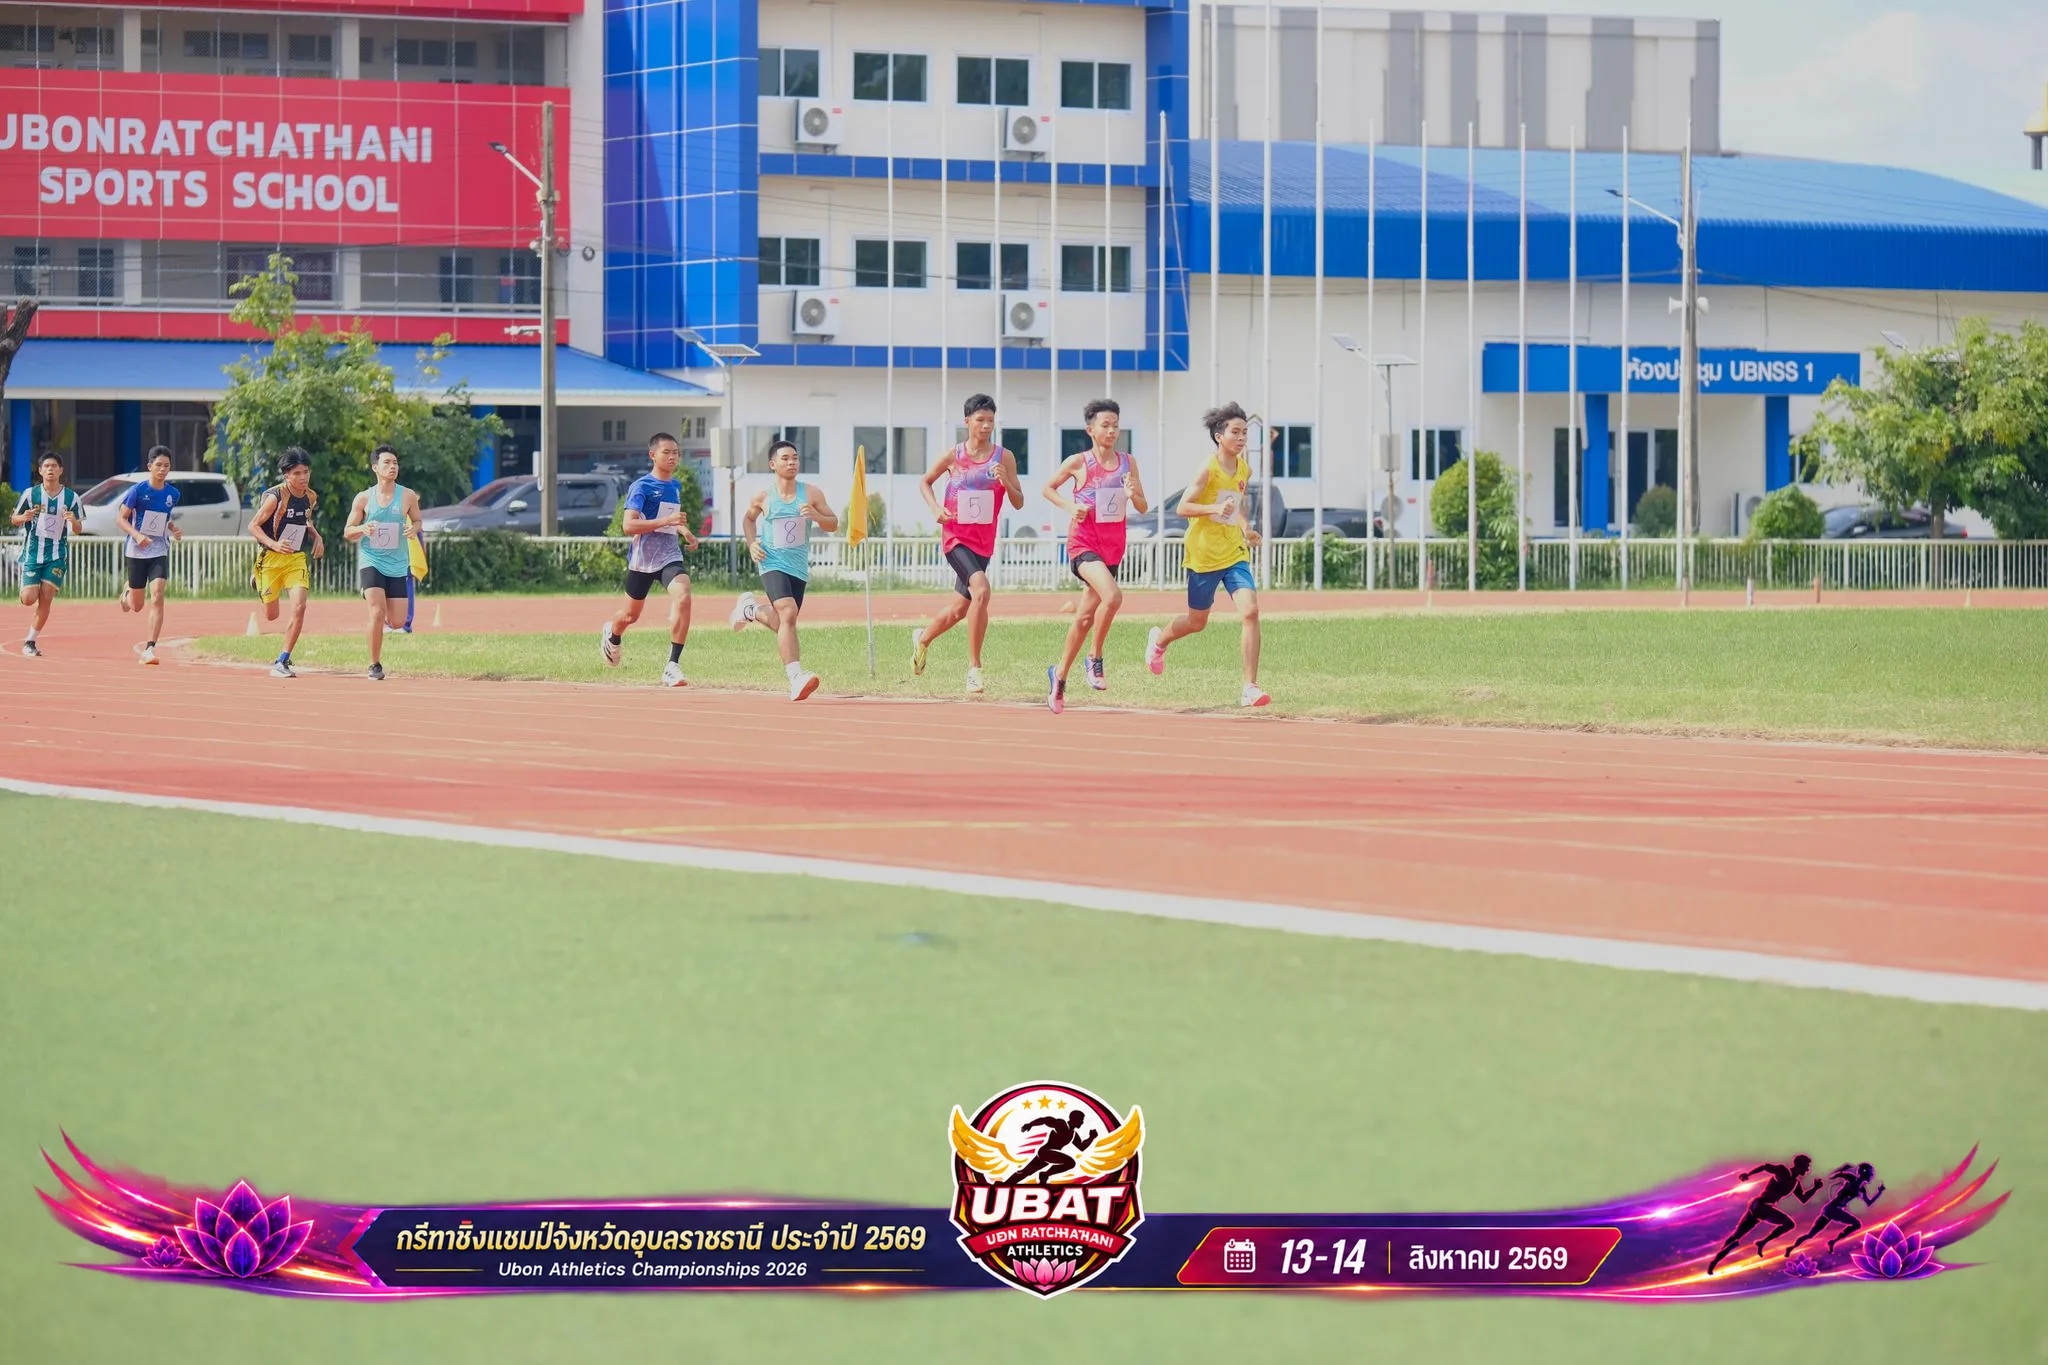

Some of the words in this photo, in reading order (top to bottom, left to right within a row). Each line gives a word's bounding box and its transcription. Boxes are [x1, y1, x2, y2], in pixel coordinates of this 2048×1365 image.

[0, 113, 432, 163] UBONRATCHATHANI
[40, 166, 208, 208] SPORTS
[233, 172, 399, 213] SCHOOL
[1730, 360, 1799, 382] UBNSS
[1805, 362, 1814, 382] 1
[968, 496, 982, 519] 5
[1107, 494, 1118, 513] 6
[44, 516, 57, 533] 2
[150, 515, 158, 530] 6
[784, 520, 797, 544] 8
[287, 528, 298, 545] 4
[377, 527, 391, 547] 5
